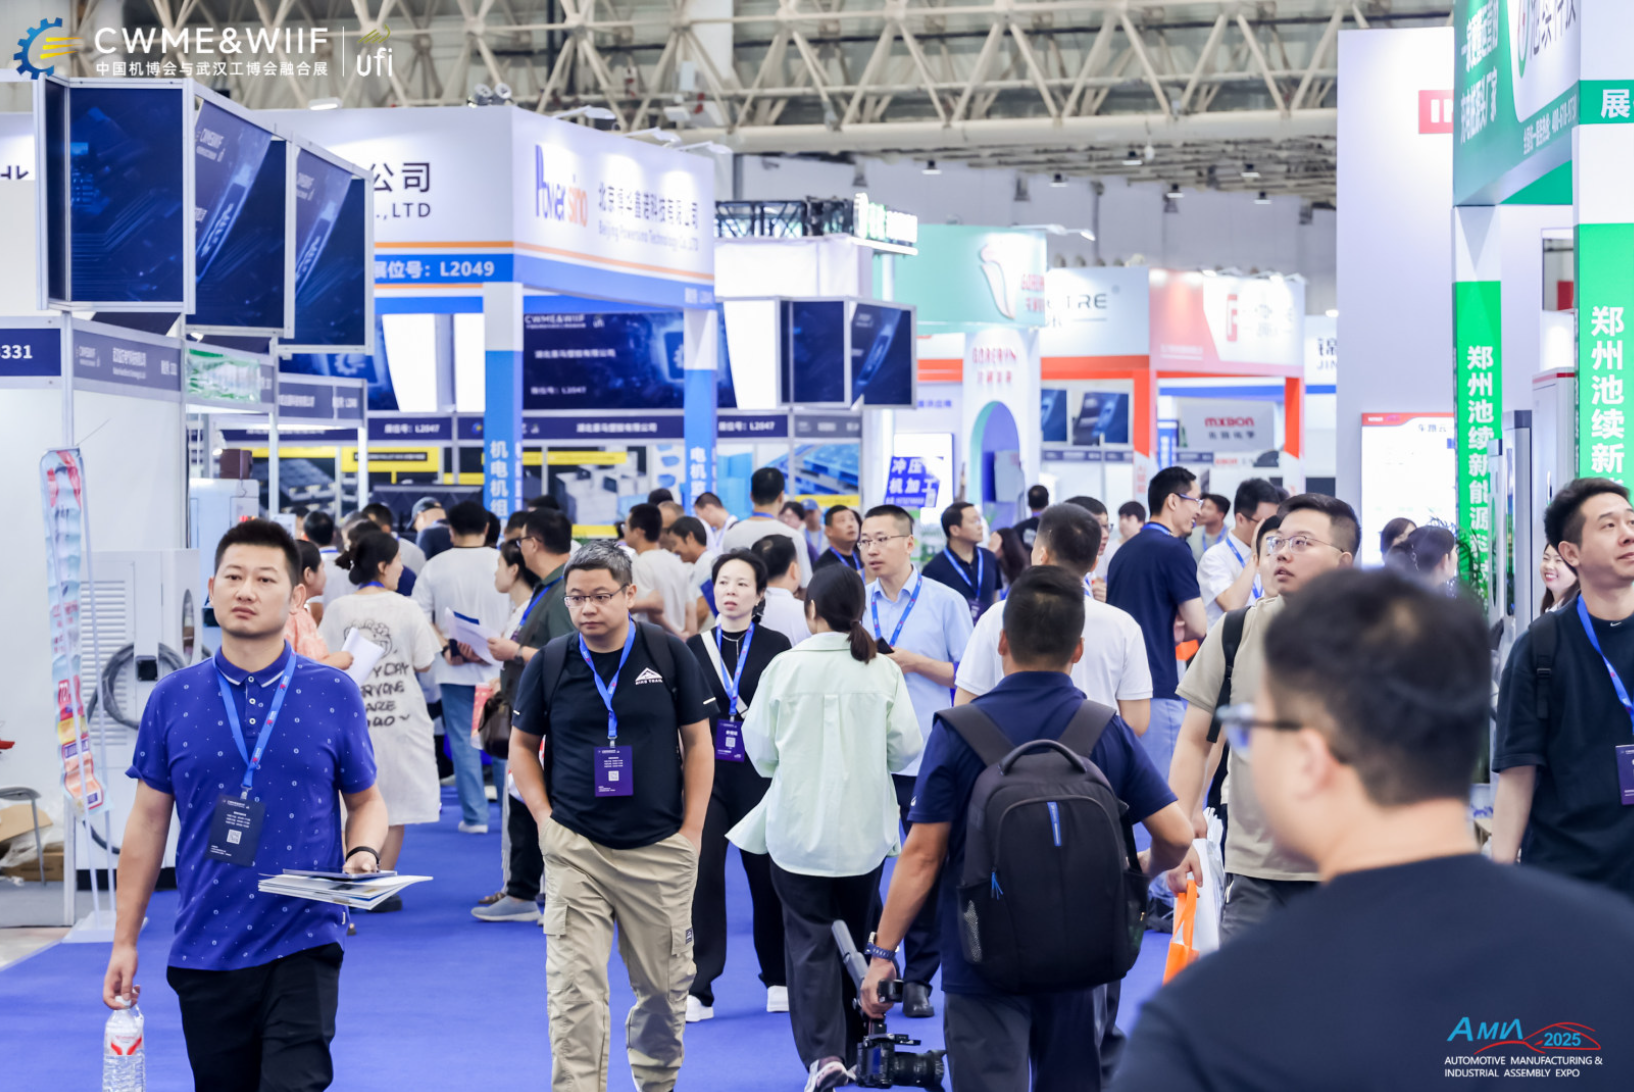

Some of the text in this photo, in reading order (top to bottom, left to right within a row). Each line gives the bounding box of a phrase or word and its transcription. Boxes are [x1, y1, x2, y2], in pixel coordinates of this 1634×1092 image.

[1600, 88, 1634, 119] 展
[440, 260, 495, 277] L2049
[1591, 306, 1625, 484] 郑州池续新
[414, 423, 440, 432] L2047
[749, 421, 775, 431] L2047
[888, 477, 938, 494] 机加工
